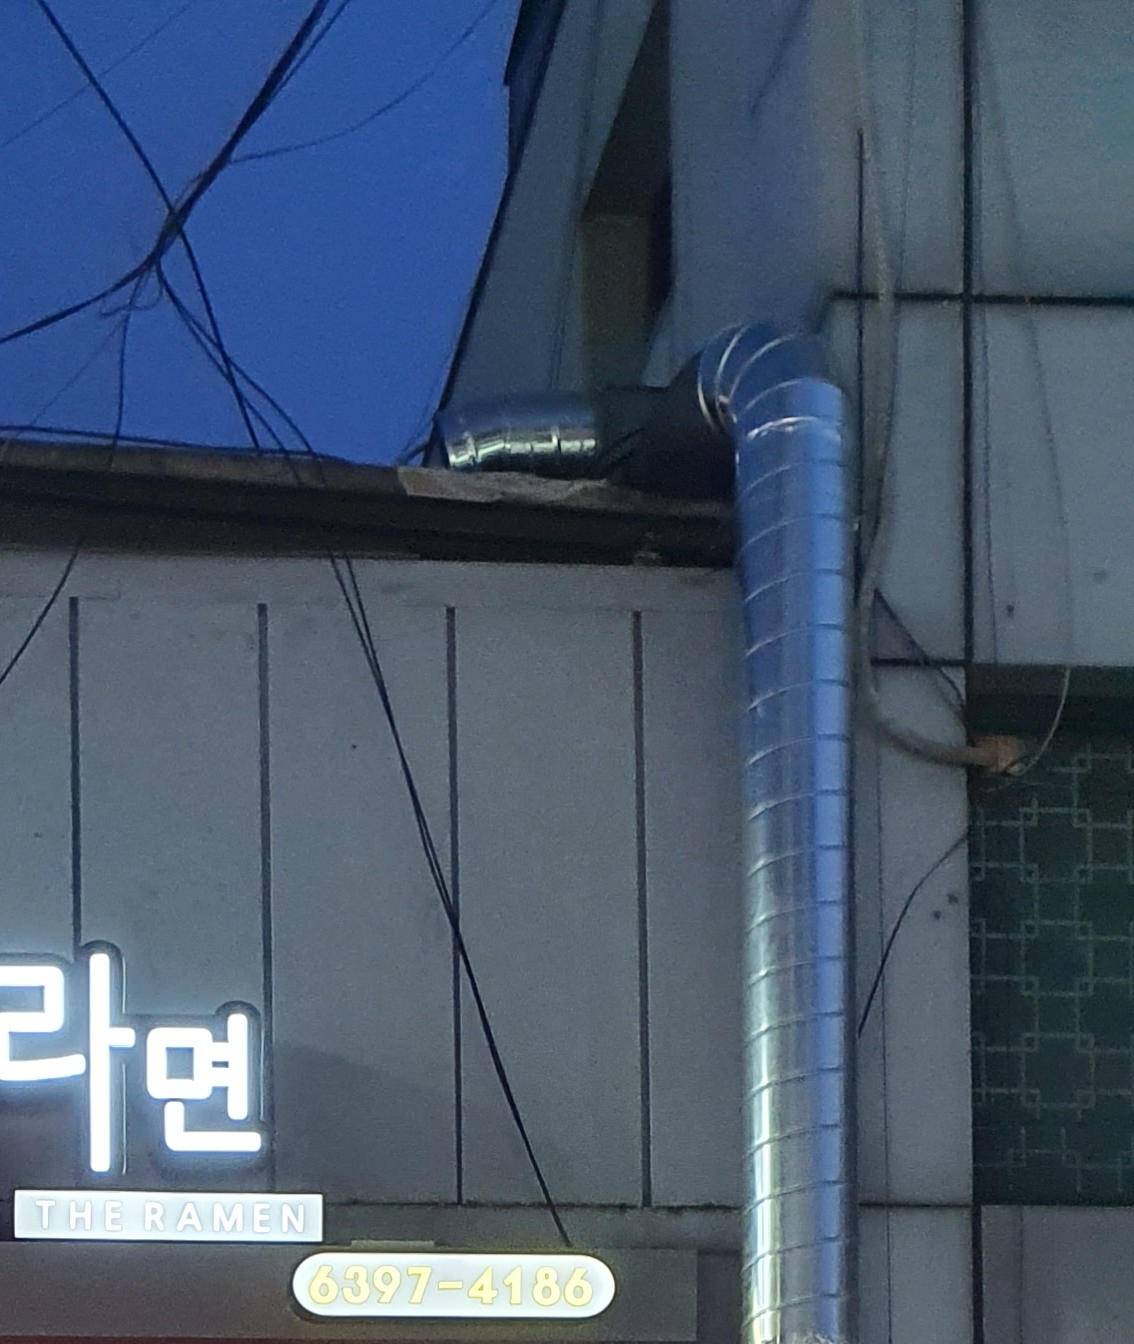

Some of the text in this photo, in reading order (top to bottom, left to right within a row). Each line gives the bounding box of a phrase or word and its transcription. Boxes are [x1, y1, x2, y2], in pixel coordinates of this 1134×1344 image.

[35, 1200, 305, 1234] THE RAMEN
[309, 1265, 593, 1306] 6397-4186
